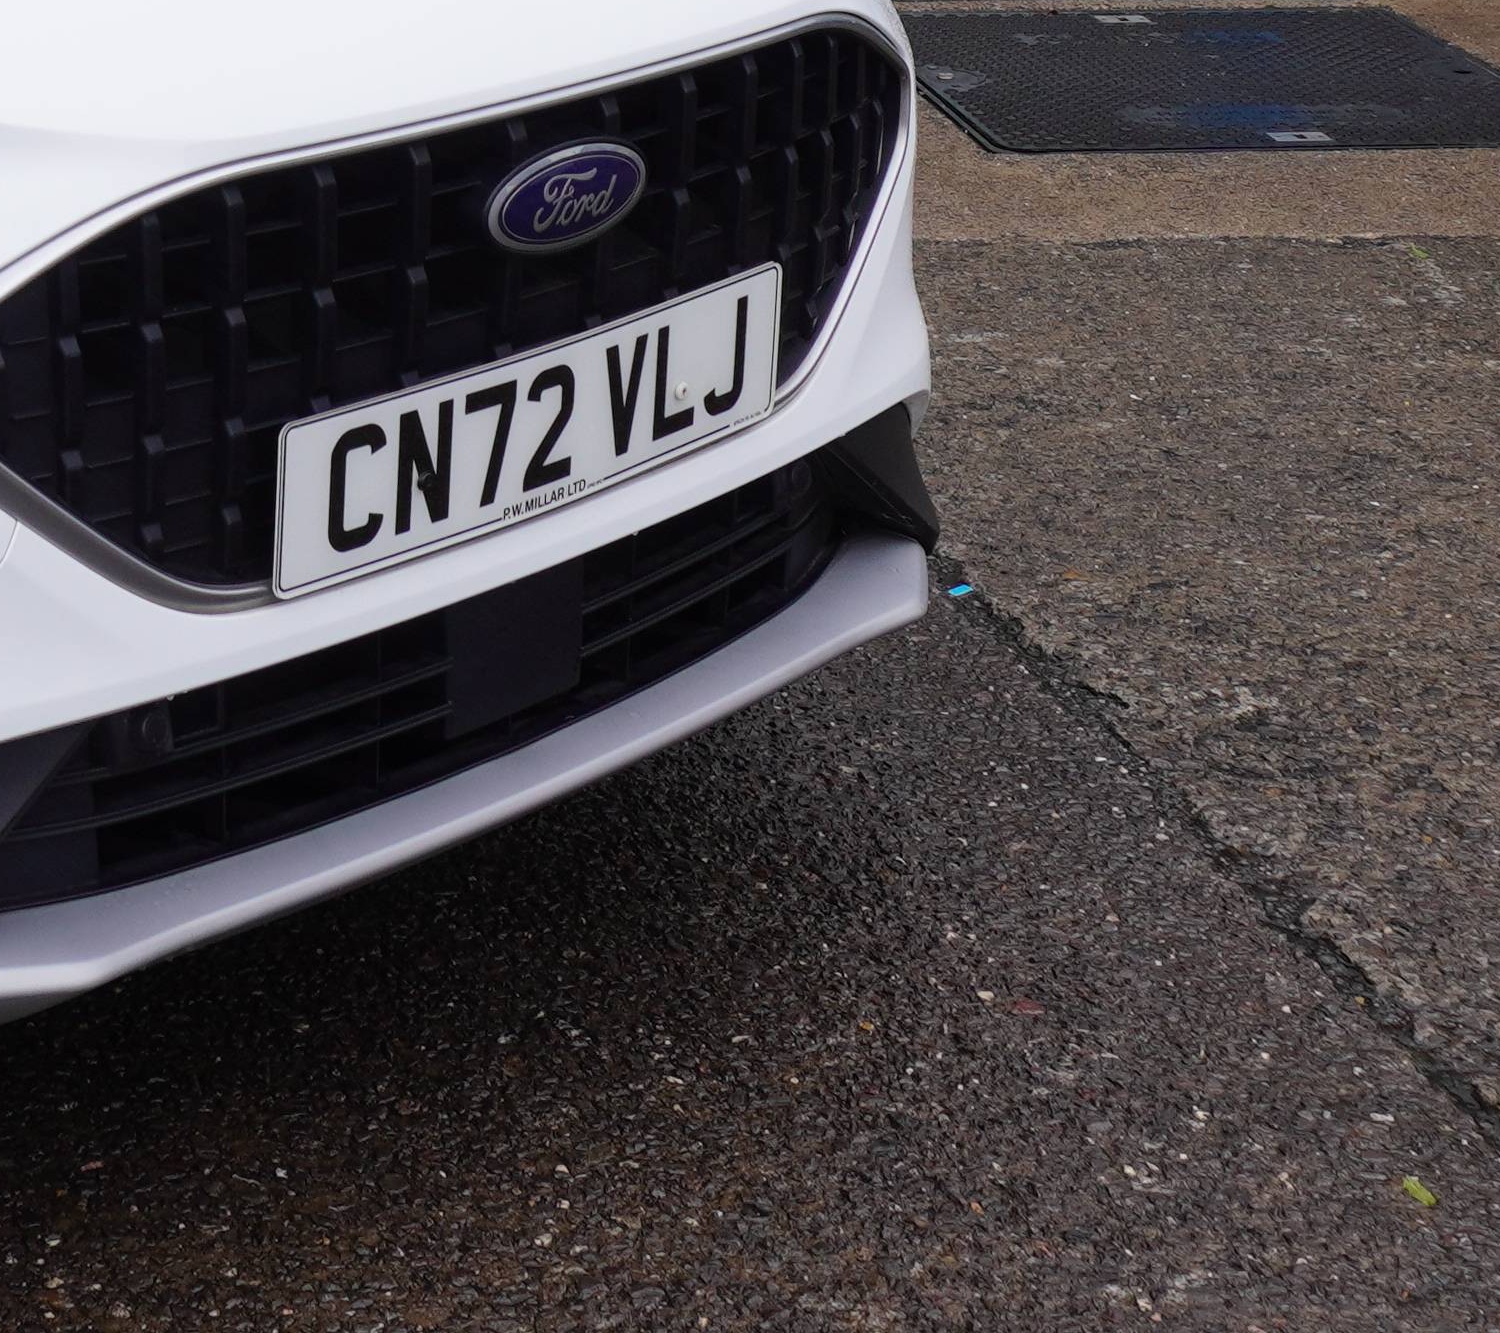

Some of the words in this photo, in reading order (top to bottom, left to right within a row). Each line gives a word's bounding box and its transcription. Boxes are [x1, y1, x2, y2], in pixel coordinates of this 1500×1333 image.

[532, 166, 618, 233] Ford
[327, 363, 575, 553] CN72
[606, 295, 749, 457] VLJ
[503, 486, 565, 520] P.W.MILLAR
[567, 479, 587, 496] LTD
